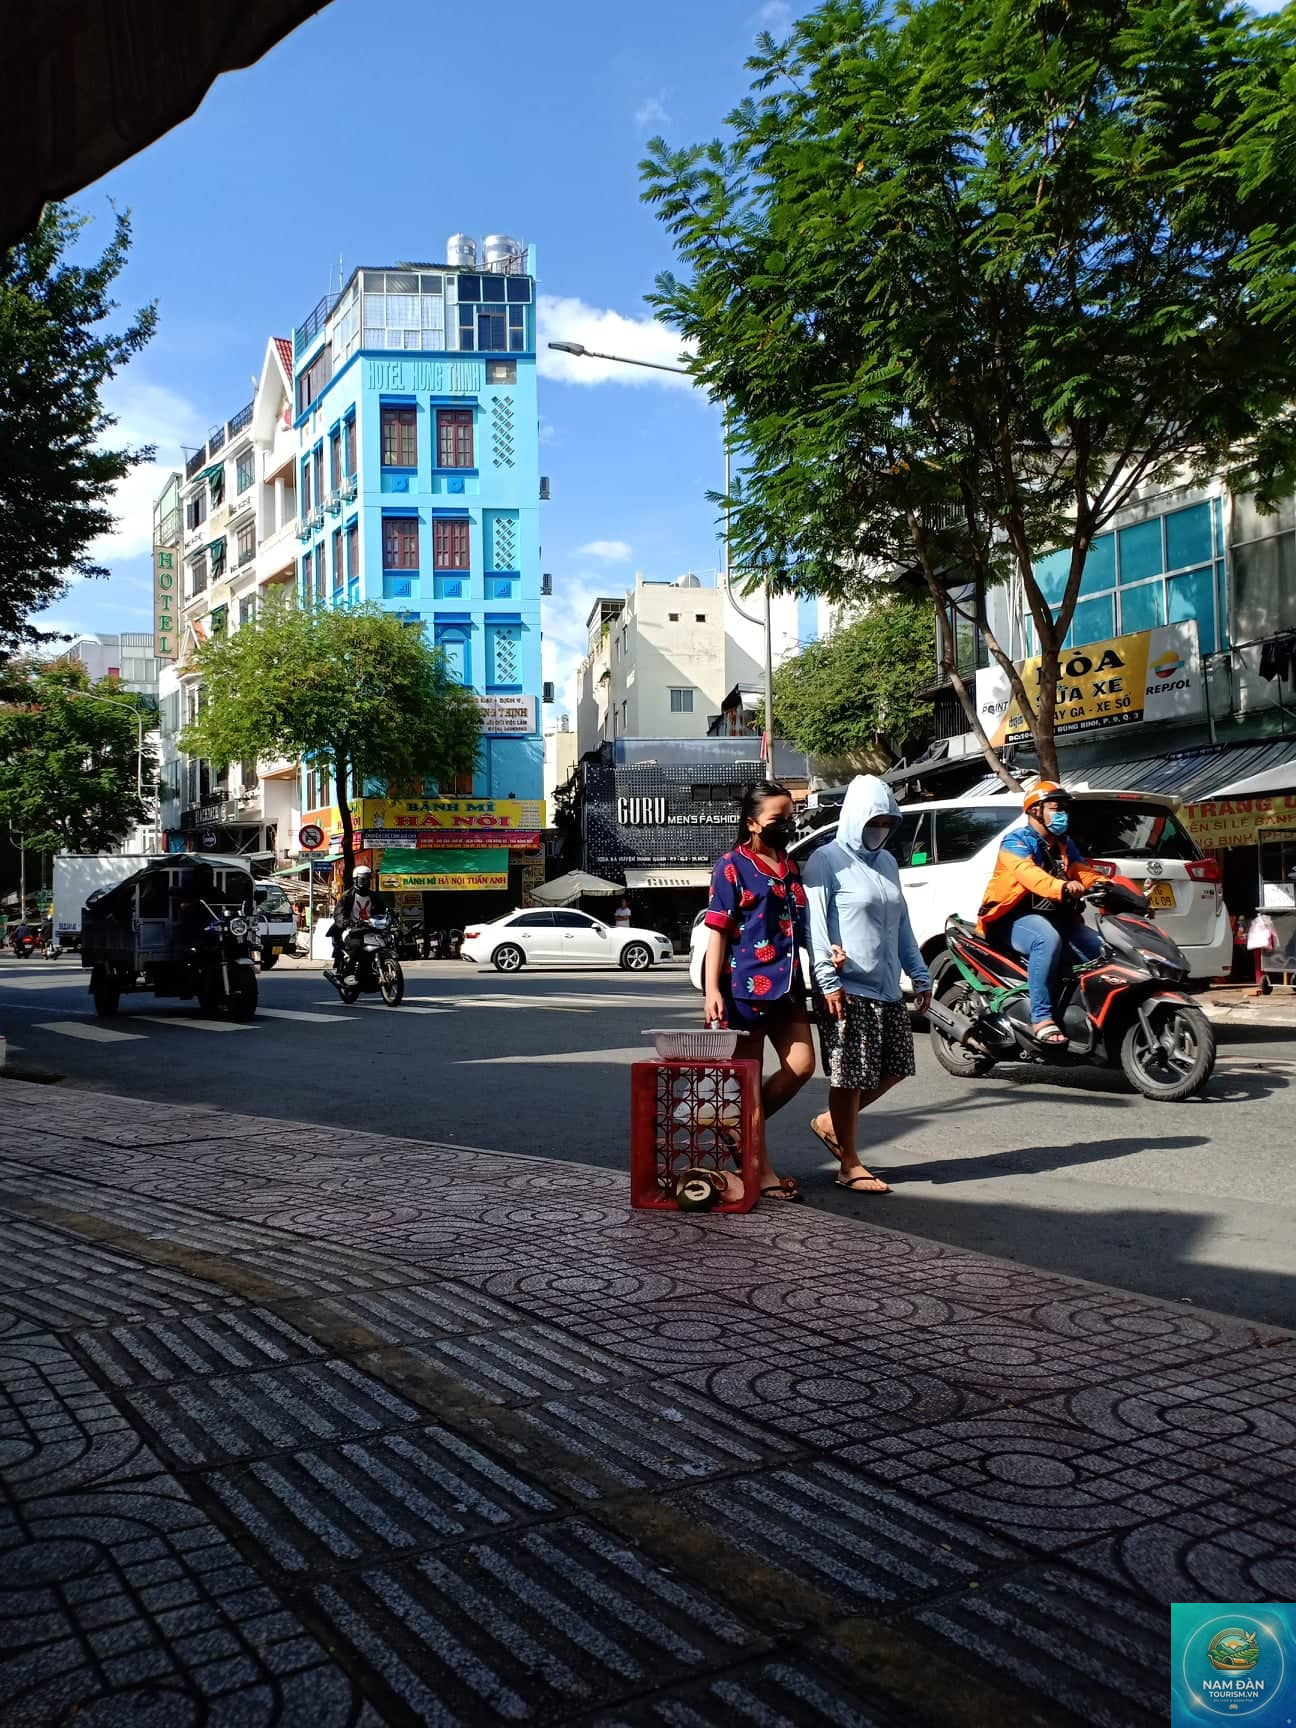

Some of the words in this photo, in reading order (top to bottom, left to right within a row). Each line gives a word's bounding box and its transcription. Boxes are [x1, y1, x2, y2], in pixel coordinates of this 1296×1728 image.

[367, 359, 405, 391] HOTEL
[158, 551, 174, 654] HOTEL
[1093, 676, 1124, 697] XE
[1145, 679, 1192, 696] REPSOL
[1070, 703, 1085, 718] GA
[1096, 699, 1111, 713] XE
[1117, 694, 1131, 709] SỐ
[407, 800, 459, 812] BÁNH
[618, 797, 666, 825] GURU
[396, 813, 441, 826] HÀ
[403, 876, 425, 885] BÁNH
[438, 876, 449, 885] HÀ
[451, 876, 465, 886] NỘI
[466, 874, 488, 885] TUẤN
[489, 876, 506, 884] ANH
